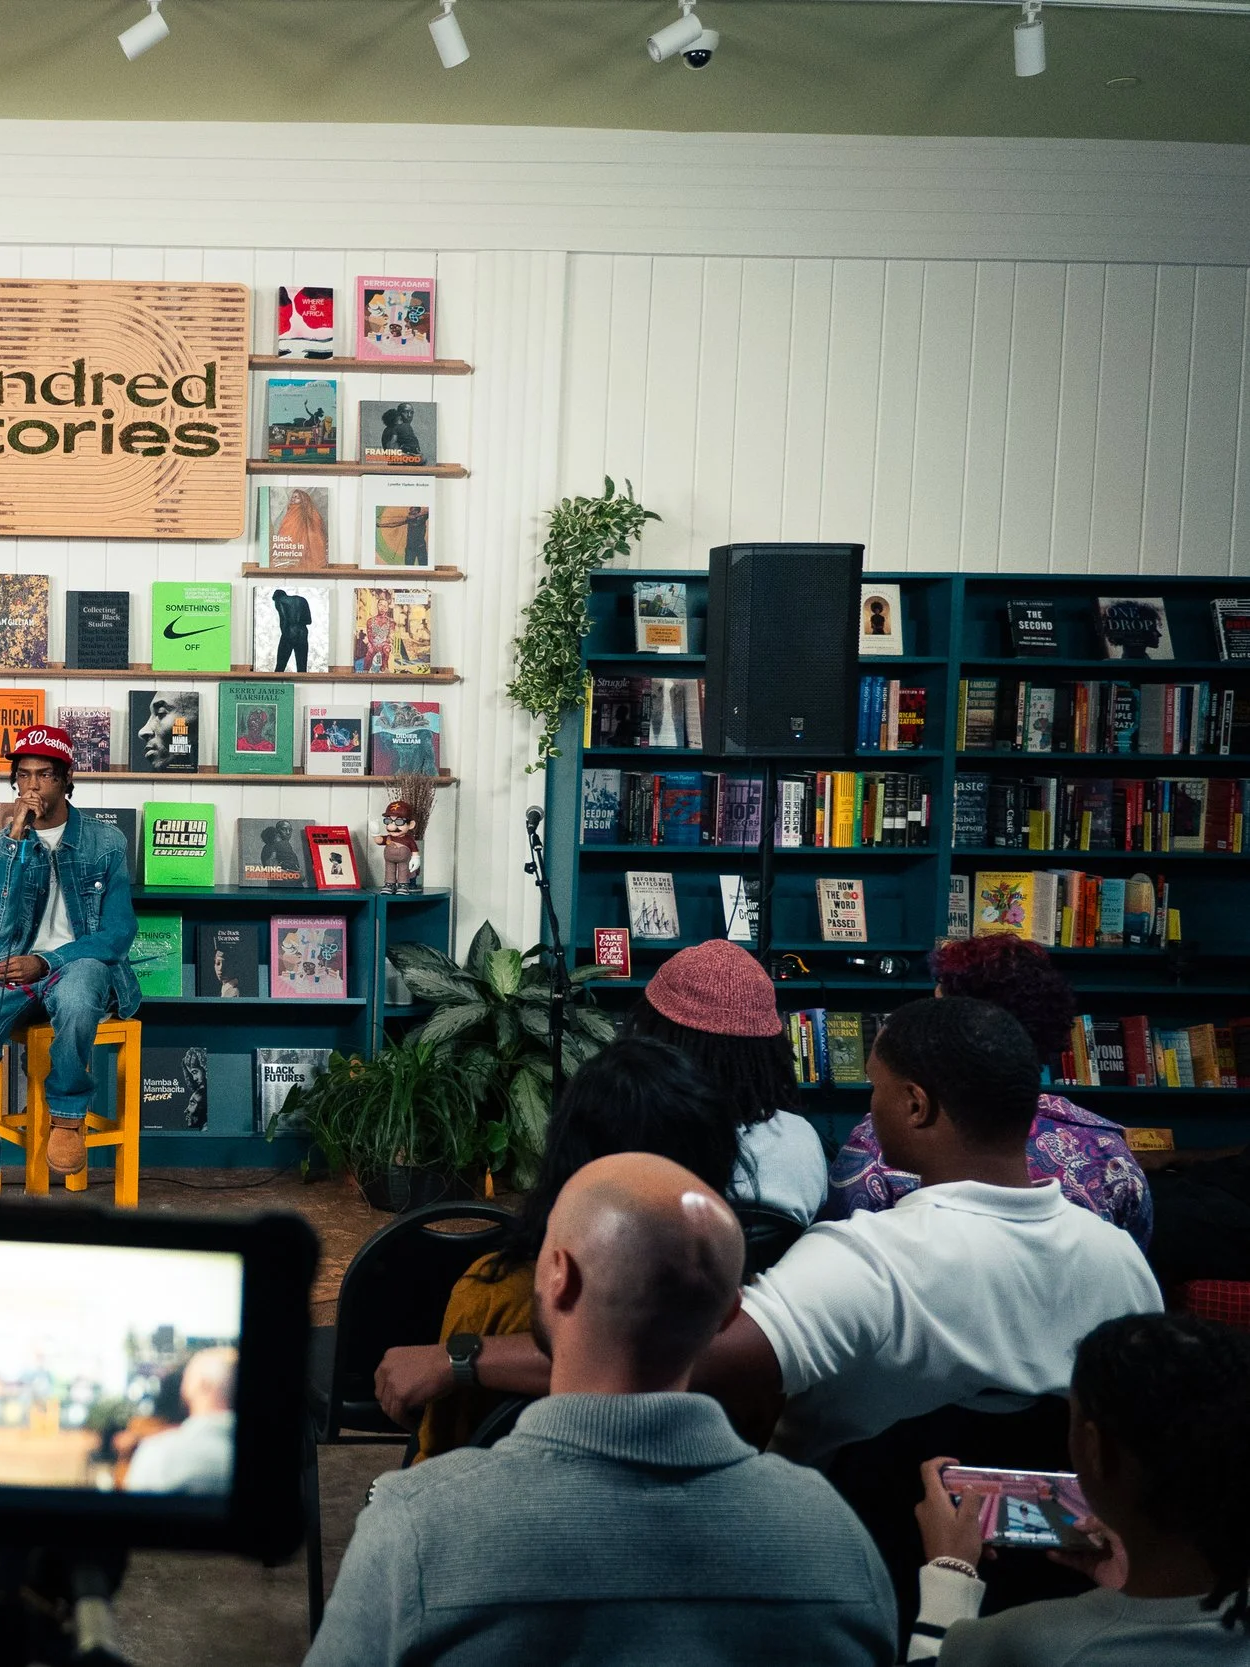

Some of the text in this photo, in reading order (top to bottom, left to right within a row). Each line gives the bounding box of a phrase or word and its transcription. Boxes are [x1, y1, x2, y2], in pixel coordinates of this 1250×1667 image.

[364, 280, 430, 289] DERRICK ADAMS
[302, 298, 324, 306] WHERE
[302, 310, 324, 318] AFRICA
[365, 448, 402, 456] FRAMING
[272, 542, 305, 550] Artists in
[272, 550, 302, 558] America
[82, 606, 116, 614] Collecting
[166, 604, 220, 612] SOMETHING'S
[1026, 610, 1042, 619] THE
[1105, 607, 1140, 618] ONE
[102, 613, 120, 621] Black
[7, 618, 35, 626] GILLIAM
[88, 620, 113, 628] Studies
[1018, 620, 1053, 630] SECOND
[1107, 619, 1155, 631] DROP
[597, 678, 630, 690] Struggle
[310, 708, 328, 716] RISE UP
[172, 726, 188, 736] BRYANT
[172, 736, 188, 744] MAMBA
[168, 744, 192, 754] MENTALITY
[957, 782, 984, 792] aste
[584, 820, 610, 830] EASON
[1006, 810, 1015, 833] Caste
[838, 882, 854, 890] HOW
[826, 890, 840, 900] THE
[834, 900, 856, 909] WORD
[830, 910, 838, 918] IS
[277, 918, 343, 926] DERRICK ADAMS
[828, 918, 856, 928] PASSED
[136, 970, 152, 978] OFF
[1096, 1046, 1124, 1059] YOND
[264, 1066, 295, 1074] BLACK
[144, 1078, 179, 1086] Mamba &
[264, 1074, 305, 1082] FUTURES
[144, 1086, 185, 1094] Mambacita
